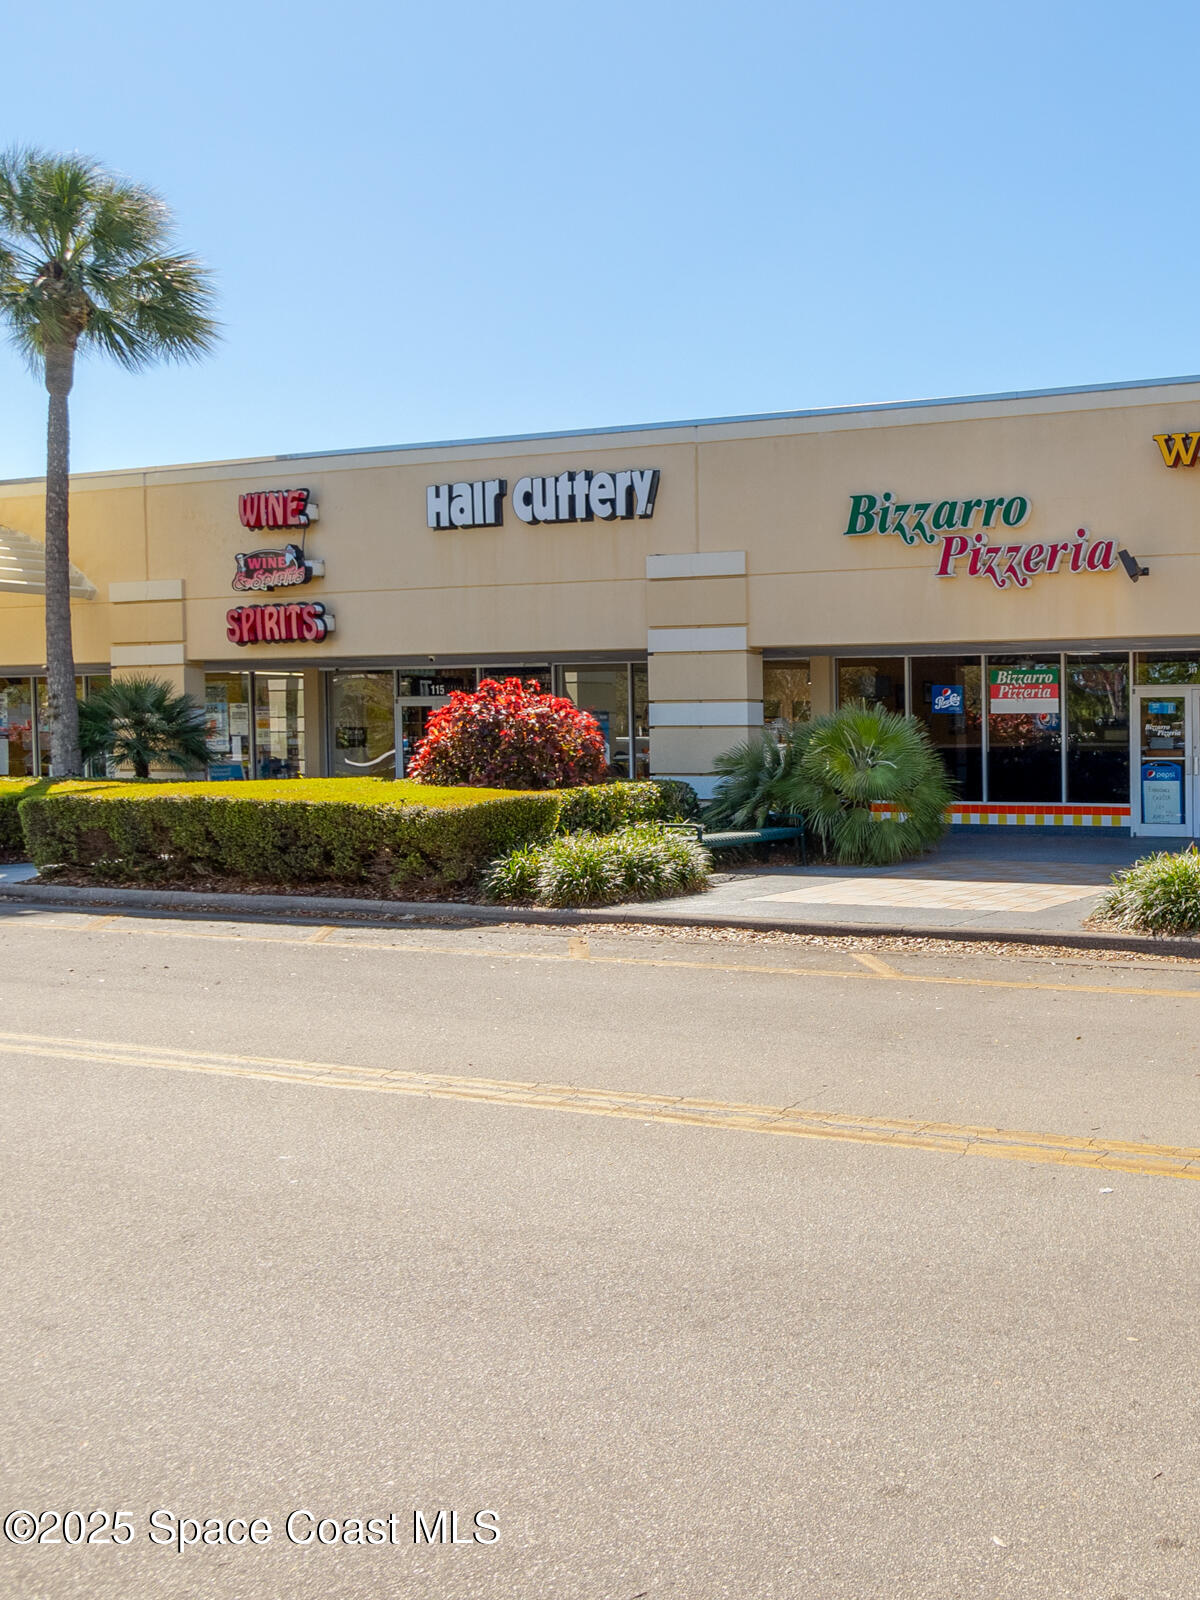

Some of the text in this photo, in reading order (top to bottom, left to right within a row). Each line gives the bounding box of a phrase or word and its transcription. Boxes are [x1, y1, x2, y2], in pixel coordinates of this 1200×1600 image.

[238, 489, 308, 529] WINE
[426, 479, 505, 529] Hair
[843, 492, 1030, 545] Bizzarro
[247, 556, 287, 569] WINE
[935, 528, 1118, 588] Pizzeria
[226, 603, 321, 643] SPIRITS
[431, 685, 445, 695] 115
[996, 671, 1053, 687] Bizzarro
[998, 685, 1051, 700] Pizzeria
